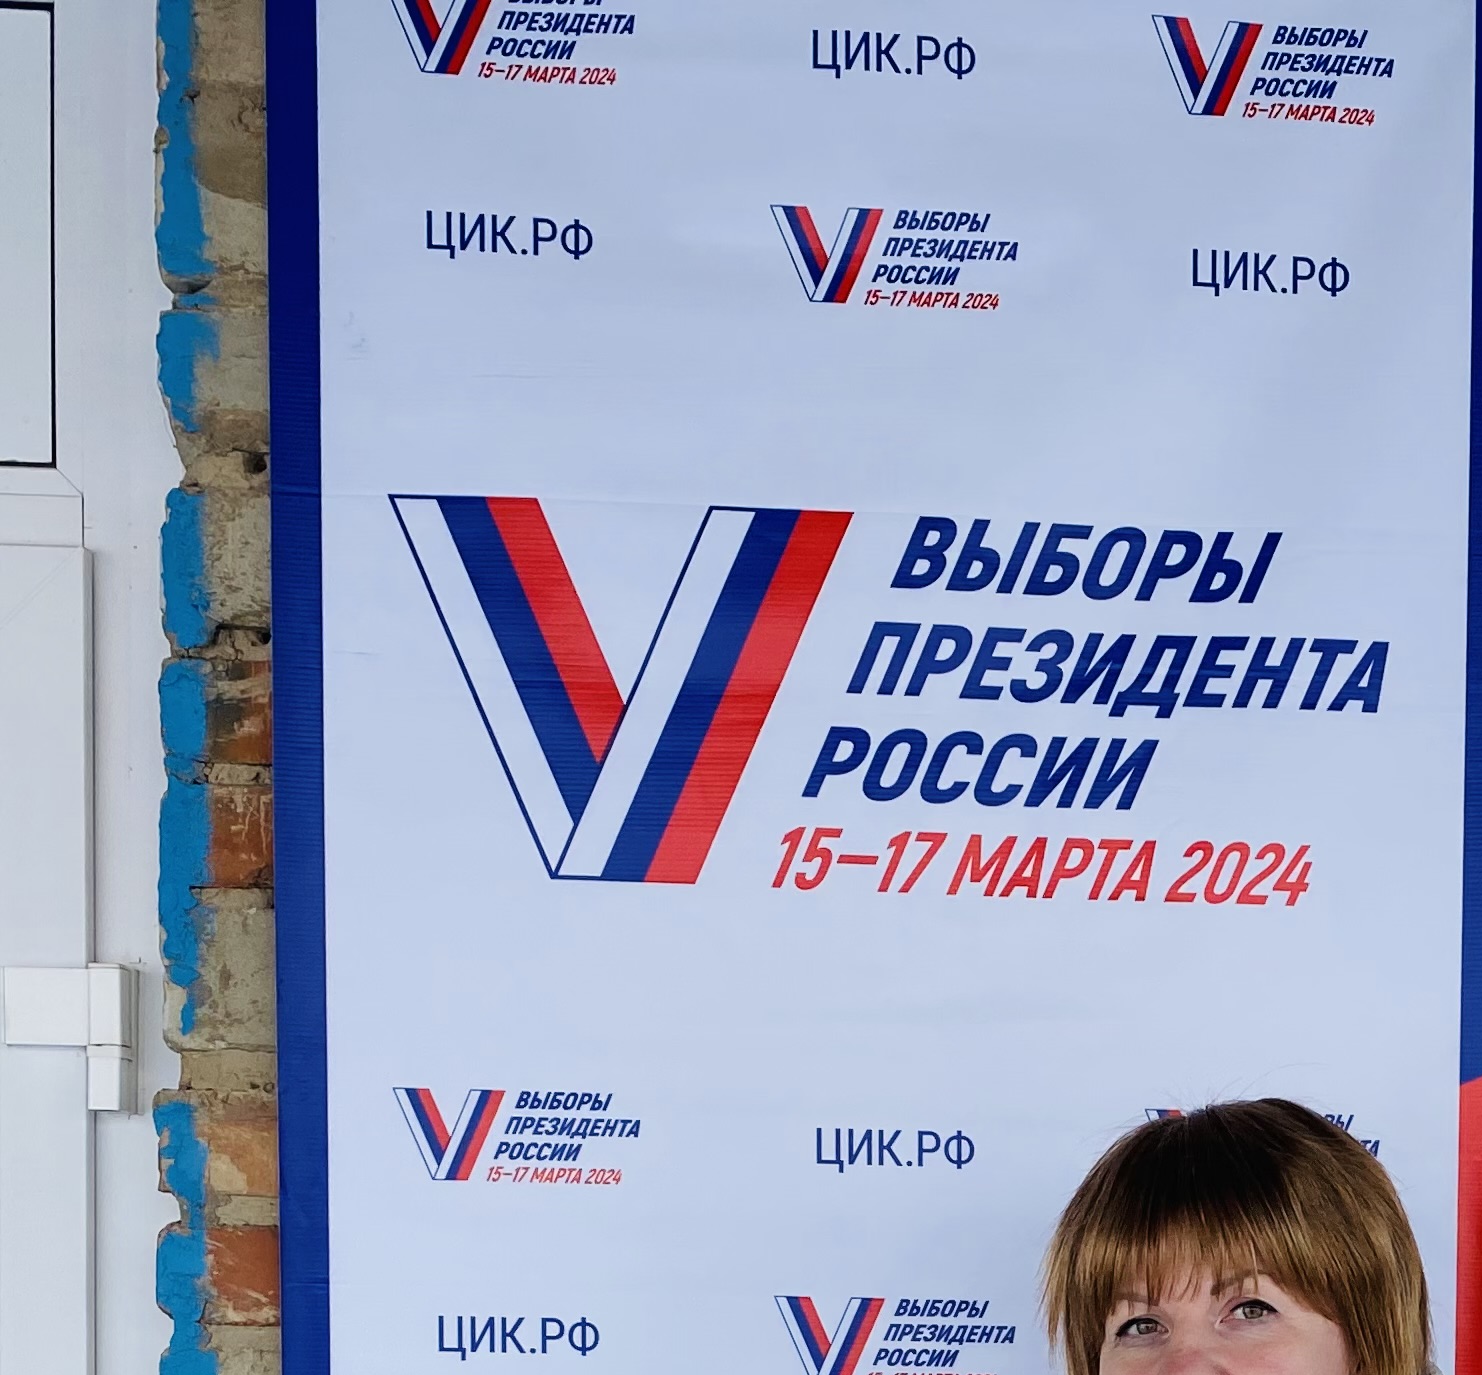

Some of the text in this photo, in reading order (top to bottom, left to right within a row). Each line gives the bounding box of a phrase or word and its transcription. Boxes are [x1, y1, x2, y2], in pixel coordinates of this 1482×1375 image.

[497, 11, 635, 36] ПРЕЗИДЕНТА
[486, 37, 576, 60] РОССИИ
[1272, 26, 1368, 48] ВЫБОРЫ
[813, 30, 975, 80] ЦИК.РФ
[1261, 52, 1394, 78] ПРЕЗИДЕНТА
[523, 65, 576, 84] МАРТА
[579, 68, 616, 85] 2024
[1250, 77, 1337, 99] РОССИИ
[1285, 104, 1337, 122] МАРТА
[1338, 108, 1375, 126] 2024
[893, 210, 991, 232] ВЫБОРЫ
[426, 210, 593, 260] ЦИК.РФ
[882, 237, 1018, 262] ПРЕЗИДЕНТА
[871, 264, 960, 285] РОССИИ
[1193, 249, 1349, 297] ЦИК.РФ
[907, 291, 960, 308] МАРТА
[962, 293, 999, 310] 2024
[890, 516, 1283, 603] ВЫБОРЫ
[846, 621, 1390, 719] ПРЕЗИДЕНТА
[802, 726, 1159, 810] РОССИИ
[946, 834, 1156, 901] МАРТА
[1164, 841, 1312, 906] 2024
[515, 1091, 613, 1111] ВЫБОРЫ
[504, 1116, 640, 1139] ПРЕЗИДЕНТА
[494, 1142, 582, 1161] РОССИИ
[817, 1128, 974, 1173] ЦИК.РФ
[530, 1167, 582, 1184] МАРТА
[585, 1169, 622, 1185] 2024
[894, 1299, 989, 1318] ВЫБОРЫ
[438, 1316, 599, 1361] ЦИК.РФ
[884, 1324, 1016, 1345] ПРЕЗИДЕНТА
[873, 1348, 959, 1367] РОССИИ
